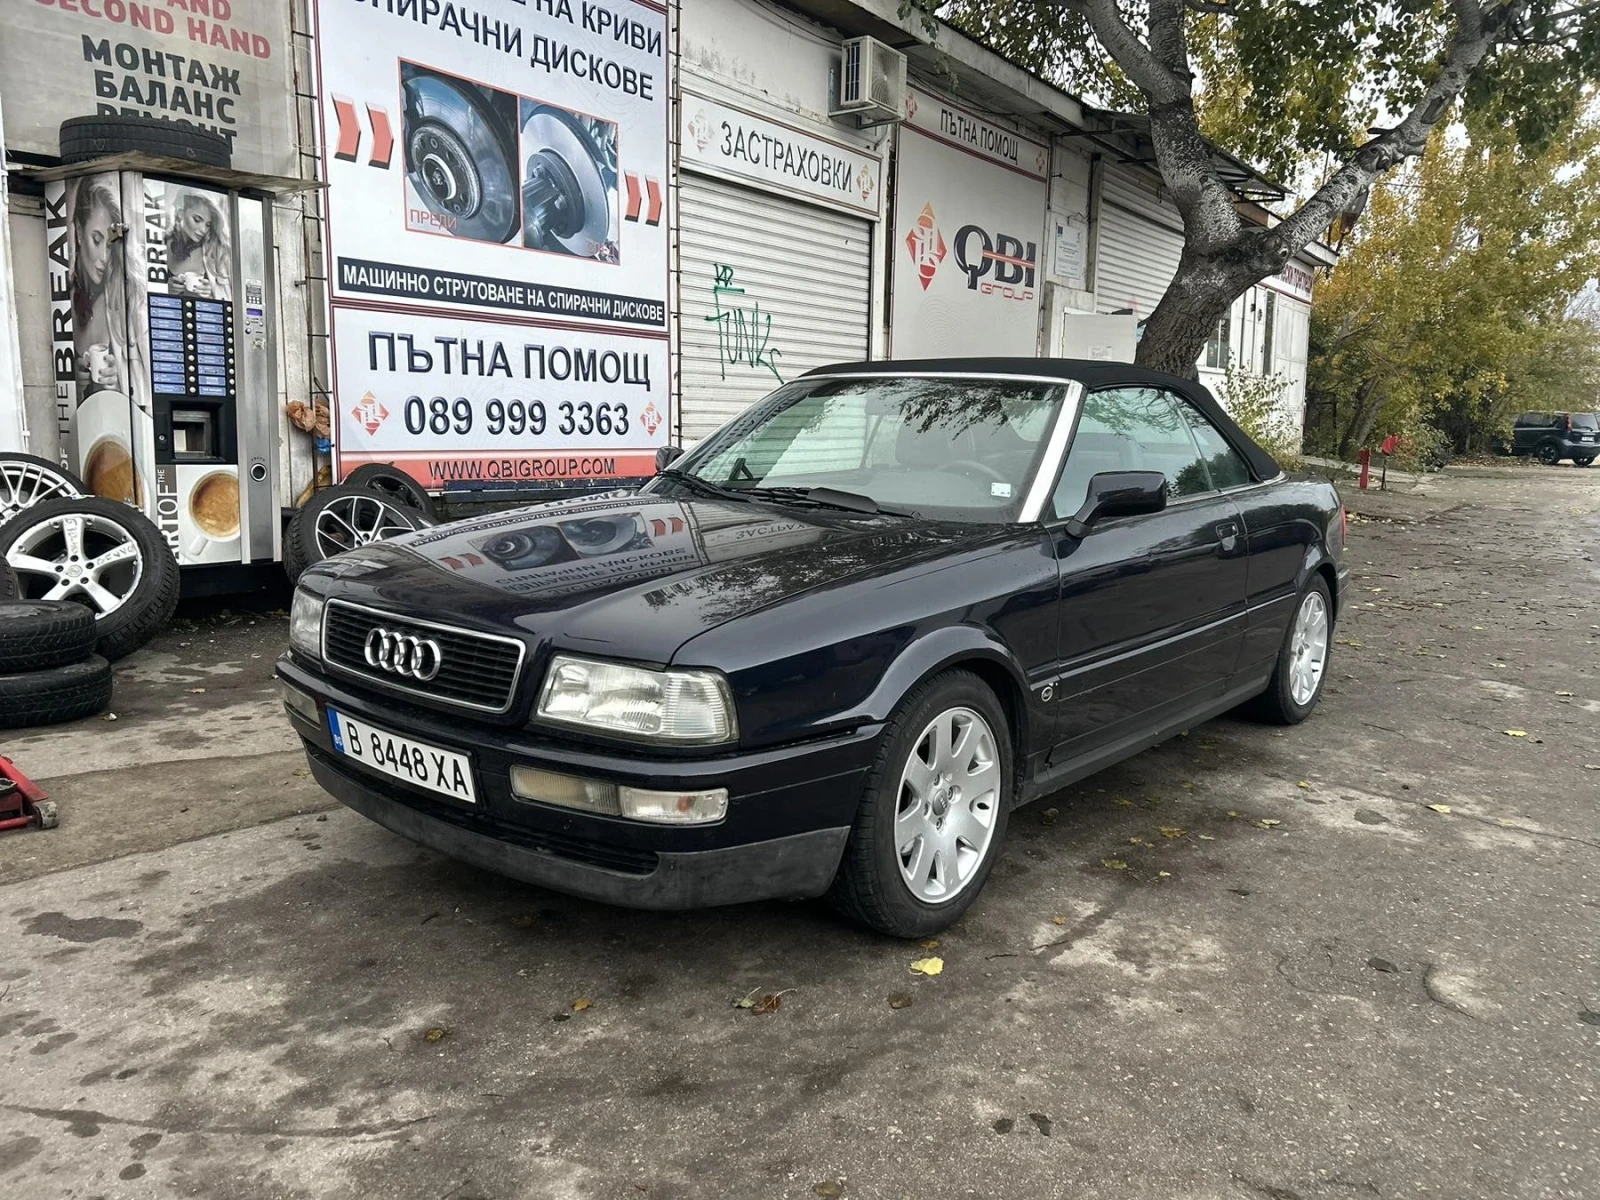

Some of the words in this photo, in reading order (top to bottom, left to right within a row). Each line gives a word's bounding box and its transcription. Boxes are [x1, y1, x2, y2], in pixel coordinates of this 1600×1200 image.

[35, 0, 174, 34] ECOND
[187, 16, 271, 59] HAND
[355, 0, 522, 57] ИРАЧНИ
[531, 34, 653, 101] ДИСКОВЕ
[582, 1, 661, 57] КРИВИ
[81, 34, 241, 95] МОНТАЖ
[94, 69, 236, 124] БАЛАНС
[720, 120, 852, 193] ЗАСТРАХОВКИ
[941, 108, 978, 146] ПЪТНА
[980, 126, 1018, 165] ПОМОЩ
[143, 193, 168, 284] BREAK
[410, 209, 458, 230] ПРЕДИ
[953, 224, 1036, 290] QBI
[47, 191, 76, 382] BREAK
[343, 264, 429, 293] МАШИННО
[433, 276, 524, 305] СТРУГОВАНЕ
[527, 288, 546, 307] НА
[547, 291, 611, 314] СПИРАЧНИ
[613, 300, 663, 321] ДИСКОВЕ
[368, 331, 513, 379] ПЪТНА
[524, 343, 651, 392] ПОМОЩ
[57, 383, 71, 440] THE
[404, 395, 473, 436] 089
[486, 398, 547, 436] 999
[558, 400, 629, 436] 3363
[157, 469, 165, 483] THE
[428, 458, 615, 480] WWW.QBIGROUP.COM
[346, 721, 362, 756] B
[370, 732, 428, 781] 8448
[431, 751, 469, 796] XA
